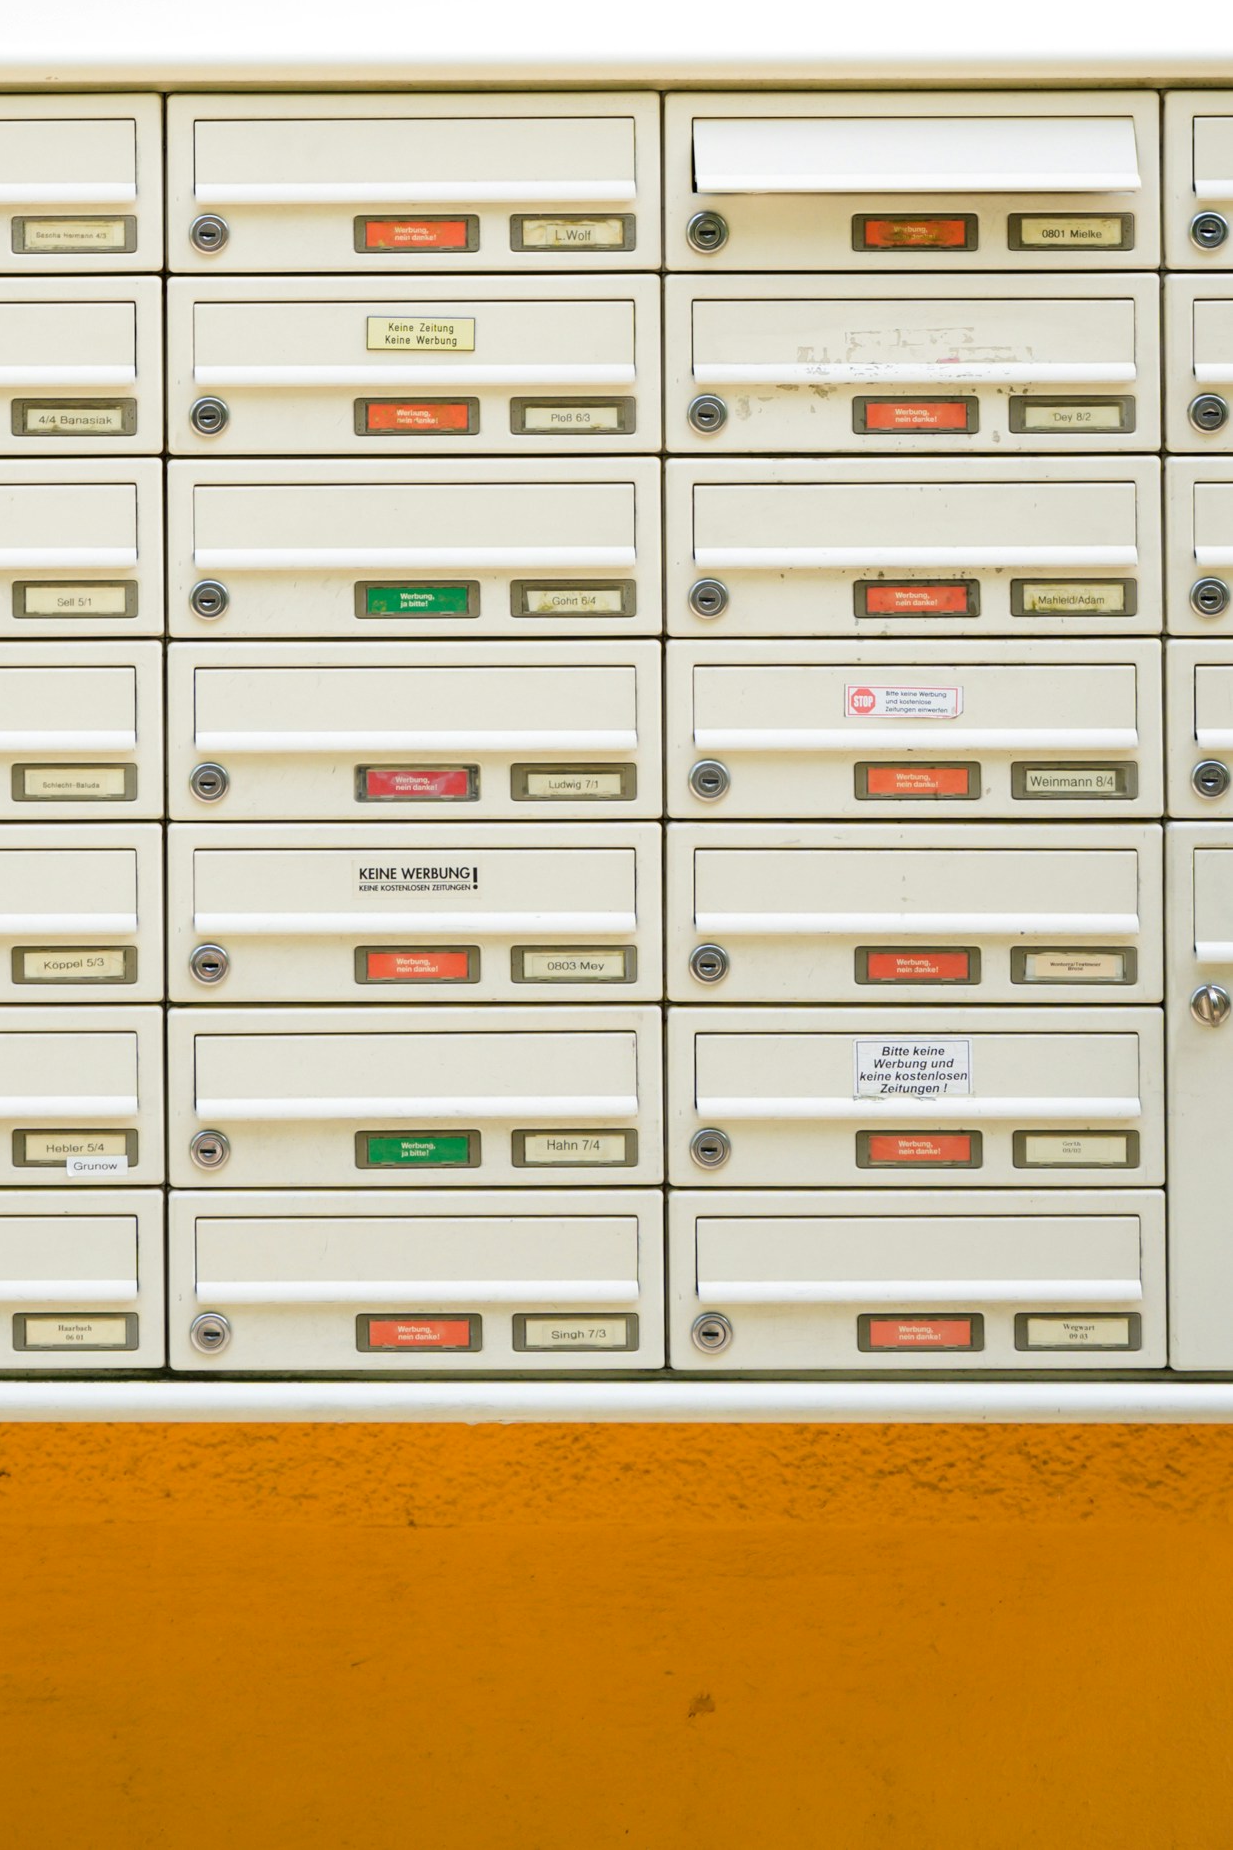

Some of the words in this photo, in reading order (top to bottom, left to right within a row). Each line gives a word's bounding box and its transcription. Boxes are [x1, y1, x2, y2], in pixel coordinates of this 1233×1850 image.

[556, 230, 591, 241] L.Wolf
[1042, 230, 1065, 238] 0801
[1071, 230, 1102, 239] Mielke
[389, 323, 414, 332] Keine
[420, 323, 454, 334] Zeitung
[385, 336, 410, 344] Keine
[417, 336, 457, 347] Werbung
[895, 408, 929, 416] Werbung,
[39, 415, 56, 425] 4/4
[61, 415, 112, 425] Banasiak
[551, 414, 573, 422] Ploß
[576, 413, 590, 422] 6/3
[912, 415, 937, 423] danke!
[1054, 413, 1073, 423] Dey
[1077, 412, 1091, 421] 8/2
[400, 593, 434, 601] Werbung,
[552, 597, 578, 606] Gohrt
[582, 597, 596, 605] 6/4
[57, 598, 74, 607] Sell
[78, 598, 92, 607] 5/1
[854, 696, 873, 707] STOP
[549, 780, 581, 790] Ludwig
[585, 780, 598, 789] 7/1
[1030, 776, 1092, 788] Weinmann
[1096, 776, 1114, 788] 8/4
[359, 868, 397, 879] KEINE
[44, 959, 83, 971] Köppel
[87, 958, 104, 968] 5/3
[548, 962, 576, 971] 0803
[580, 962, 604, 972] Mey
[882, 1047, 909, 1056] Bitte
[913, 1047, 945, 1056] keine
[874, 1059, 927, 1070] Werbung
[931, 1059, 954, 1068] und
[860, 1072, 891, 1081] keine
[895, 1071, 967, 1081] kostenlosen
[880, 1084, 939, 1095] Zeitungen
[46, 1144, 83, 1153] Hebler
[87, 1143, 104, 1153] 5/4
[401, 1142, 435, 1150] Werbung,
[547, 1140, 578, 1150] Hahn
[582, 1140, 600, 1150] 7/4
[402, 1150, 408, 1158] ja
[74, 1161, 117, 1170] Grunow
[398, 1326, 431, 1334] Werbung,
[1063, 1324, 1094, 1332] Wegwart
[552, 1330, 584, 1341] Singh
[588, 1330, 606, 1339] 7/3
